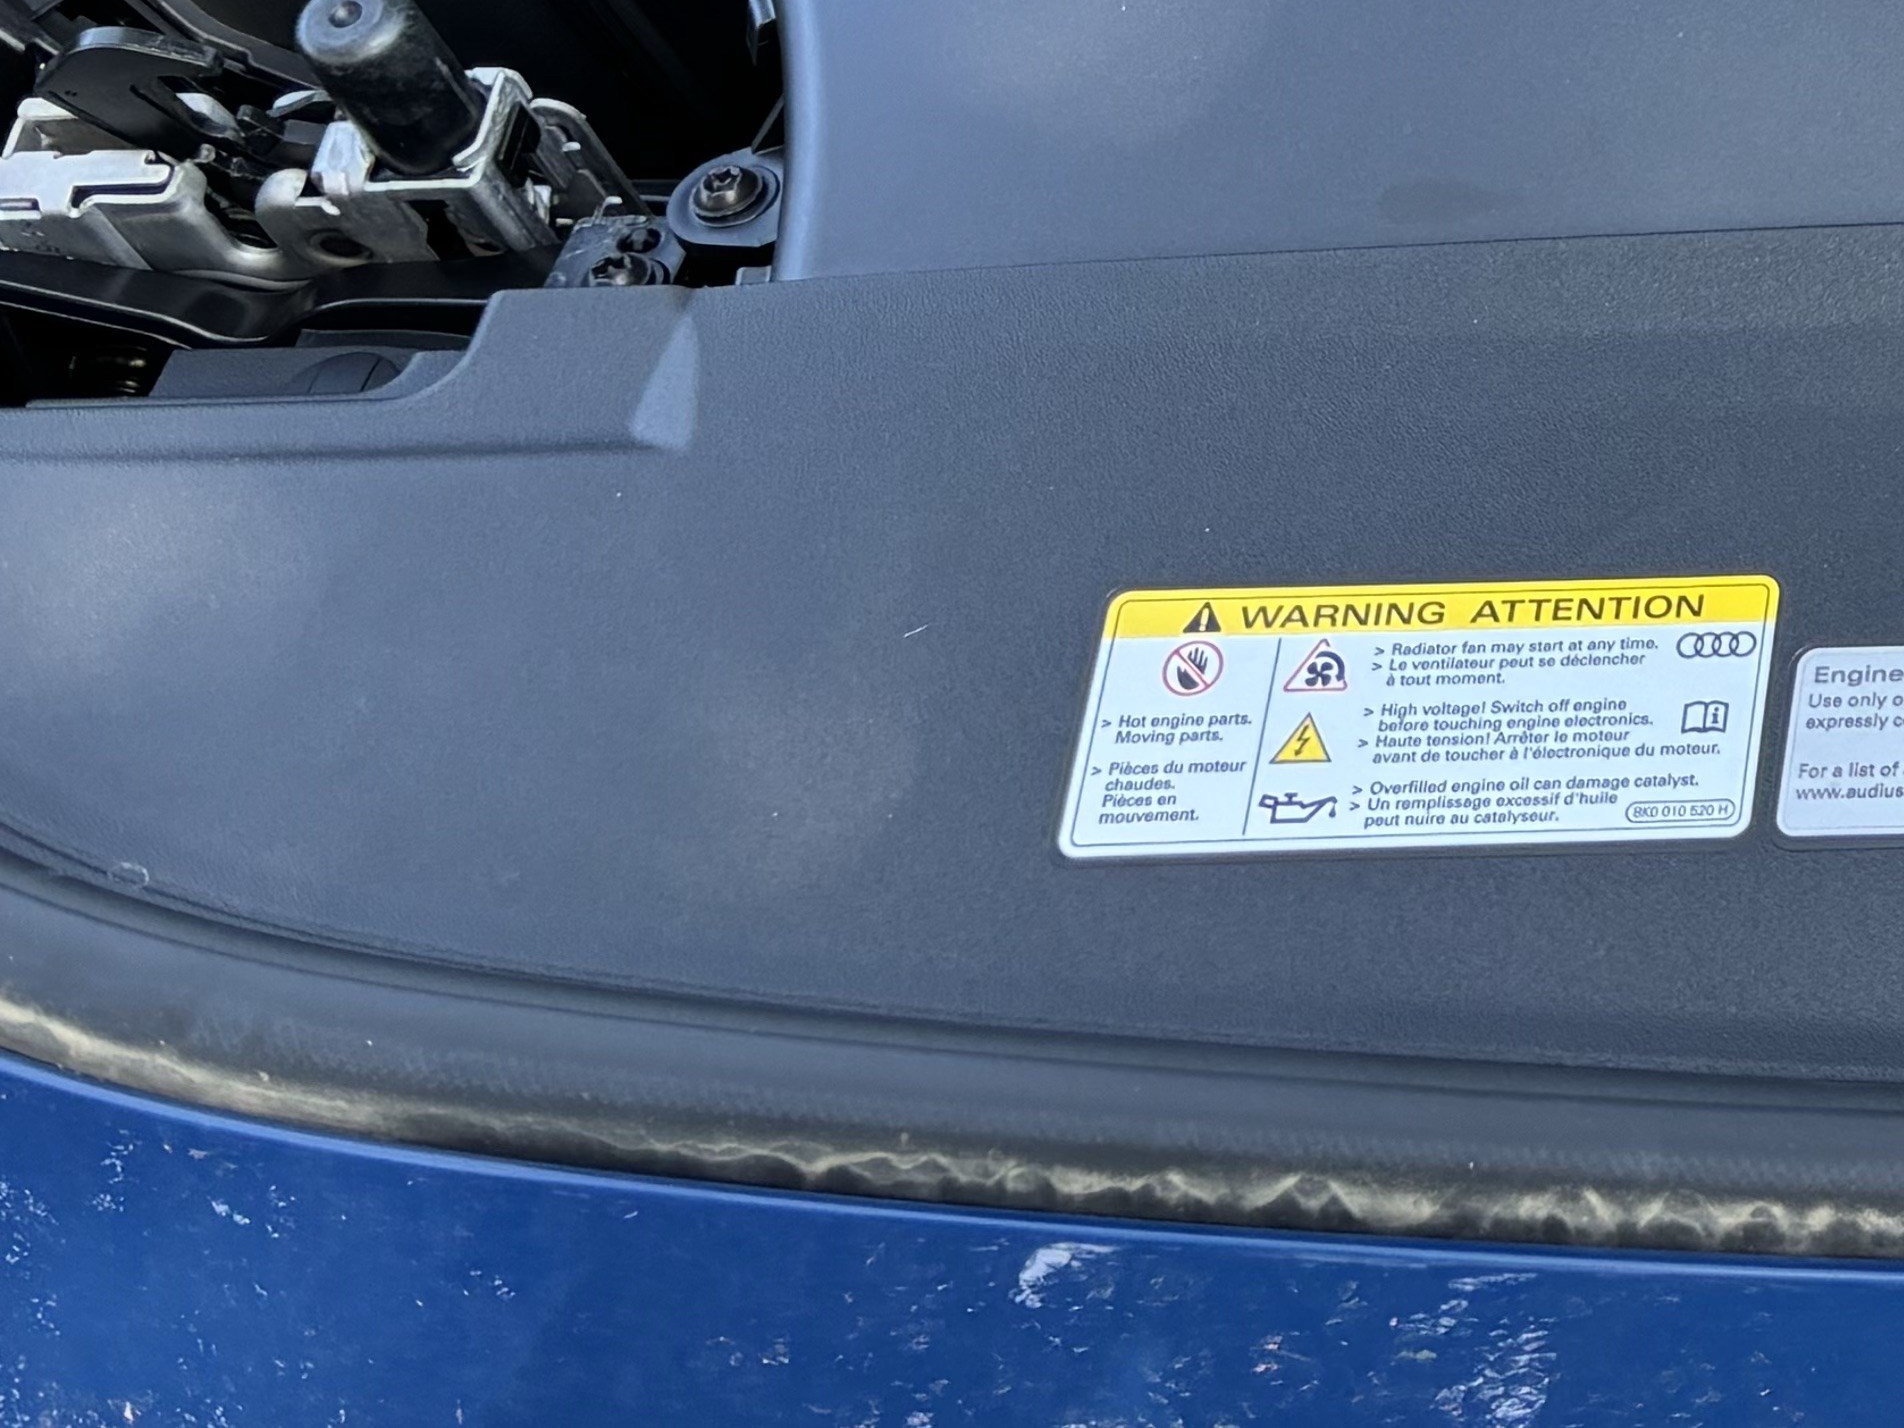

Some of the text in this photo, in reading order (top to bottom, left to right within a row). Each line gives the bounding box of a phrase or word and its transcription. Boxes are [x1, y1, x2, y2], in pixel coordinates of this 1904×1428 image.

[1241, 594, 1705, 629] WARNING ATTENTION
[1391, 637, 1659, 656] Radiator fan may start at any time.
[1389, 652, 1646, 672] Le ventilateur peut se déclencher
[1385, 672, 1505, 687] à tout moment.
[1814, 664, 1904, 687] Engine
[1381, 703, 1418, 719] High
[1490, 700, 1544, 715] Switch
[1548, 699, 1570, 713] off
[1572, 698, 1627, 714] engine
[1808, 693, 1843, 709] Use
[1847, 691, 1888, 710] only
[1118, 713, 1252, 730] Hot engine parts.
[1377, 712, 1654, 732] before touching engine electronics.
[1805, 713, 1889, 732] expressly
[1115, 730, 1224, 746] Moving parts.
[1375, 734, 1422, 748] Haute
[1493, 730, 1550, 745] Arrêter
[1553, 730, 1568, 743] le
[1572, 730, 1630, 742] moteur
[1372, 743, 1721, 765] avant de toucher à l'électronique du moteur.
[1108, 760, 1247, 776] Pièces du moteur
[1798, 763, 1829, 779] For
[1832, 766, 1843, 778] a
[1848, 761, 1875, 778] list
[1879, 760, 1900, 778] of
[1104, 777, 1176, 792] chaudes.
[1369, 773, 1699, 796] Overfilled engine oil can damage catalyst.
[1101, 794, 1177, 808] Pièces en
[1367, 791, 1618, 812] Un remplissage excessif d'huile
[1098, 808, 1199, 825] mouvement.
[1363, 810, 1559, 830] peut nuire au catalyseur.
